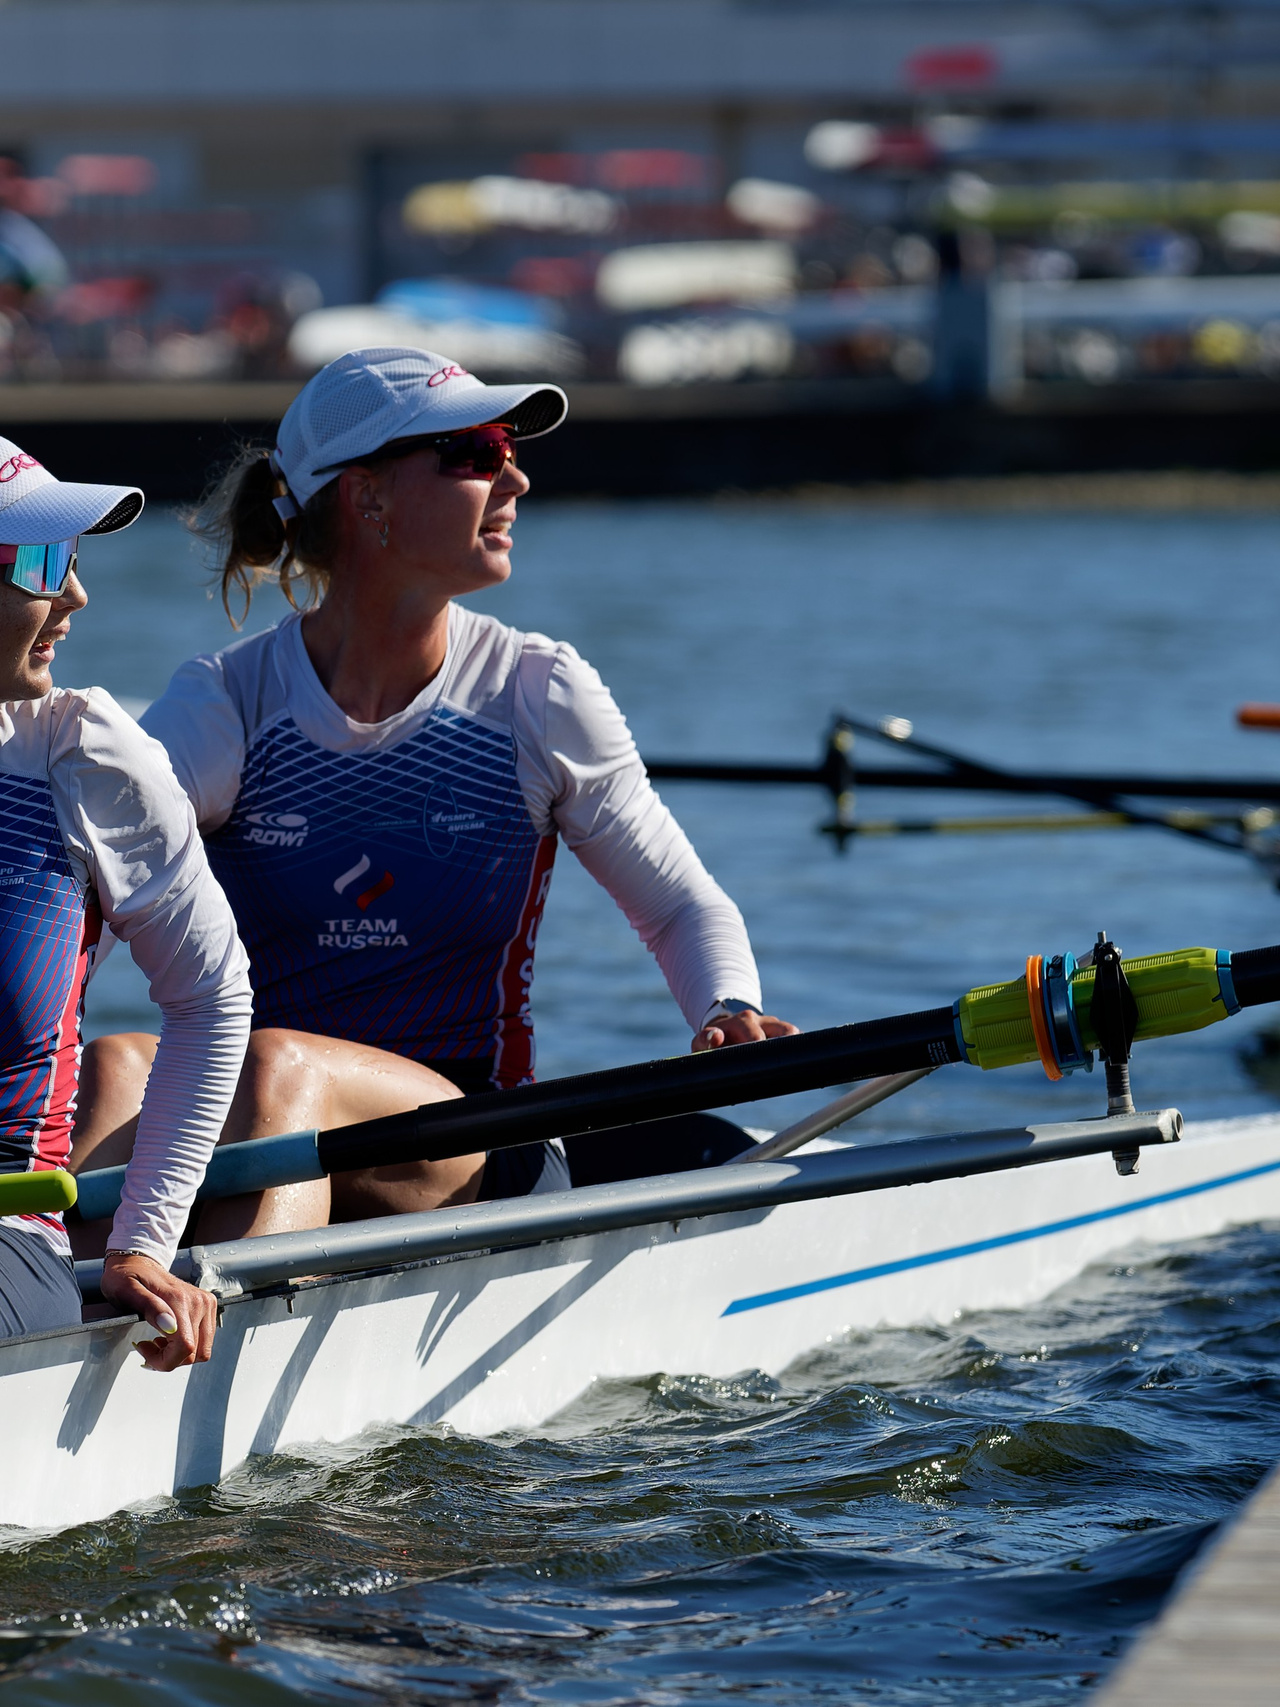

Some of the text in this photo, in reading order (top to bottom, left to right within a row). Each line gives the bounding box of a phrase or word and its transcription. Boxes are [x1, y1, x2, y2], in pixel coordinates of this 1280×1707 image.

[441, 813, 475, 823] VSMPO
[447, 822, 485, 832] AVISMA
[324, 918, 397, 933] TEAM
[318, 934, 409, 950] RUSSIA
